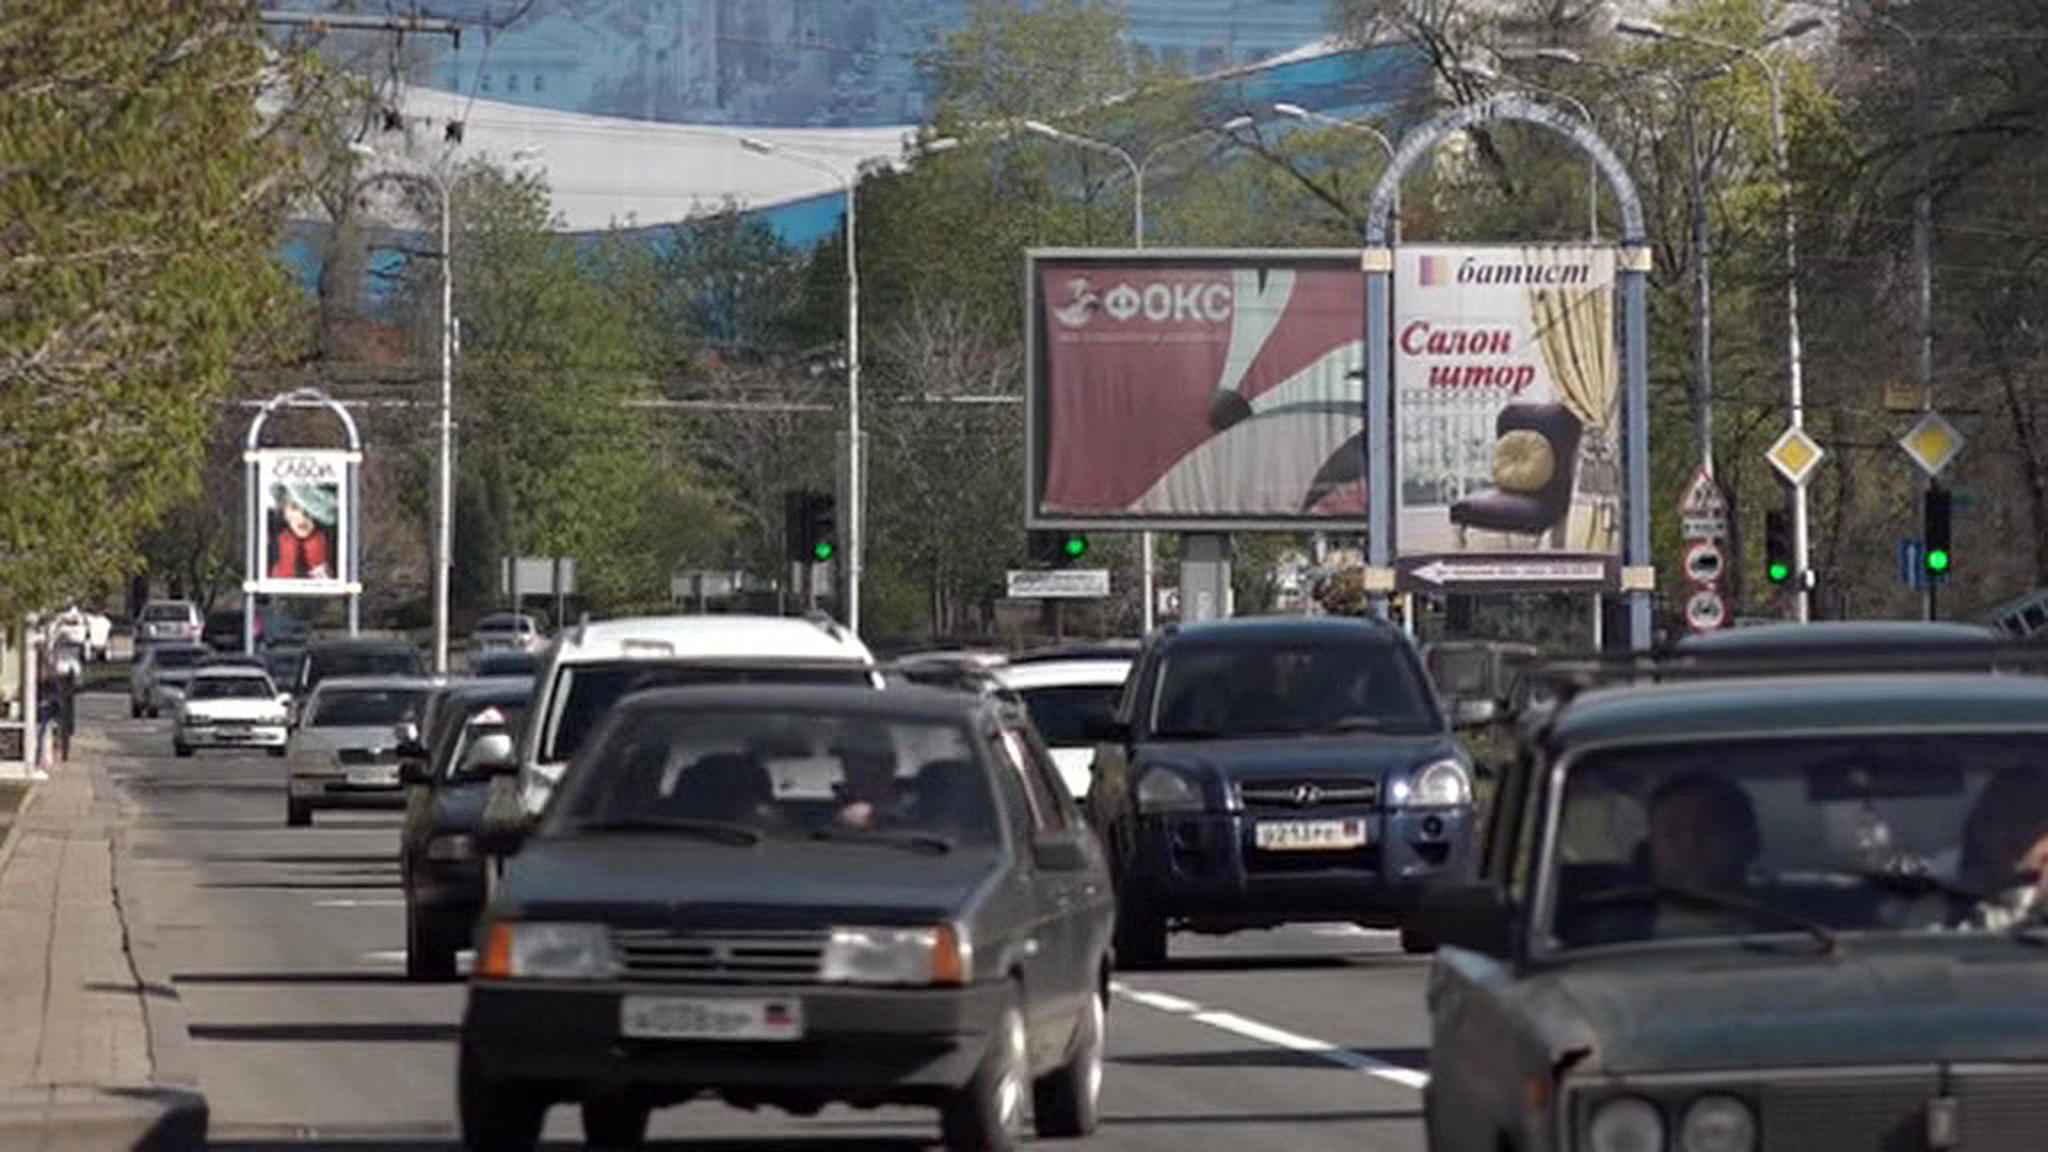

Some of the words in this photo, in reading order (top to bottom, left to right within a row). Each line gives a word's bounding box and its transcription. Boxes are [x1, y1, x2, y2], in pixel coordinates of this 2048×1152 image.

[1456, 257, 1590, 284] батист
[1105, 282, 1232, 322] ФОКС
[1400, 321, 1512, 356] Салон
[1430, 364, 1536, 397] штор
